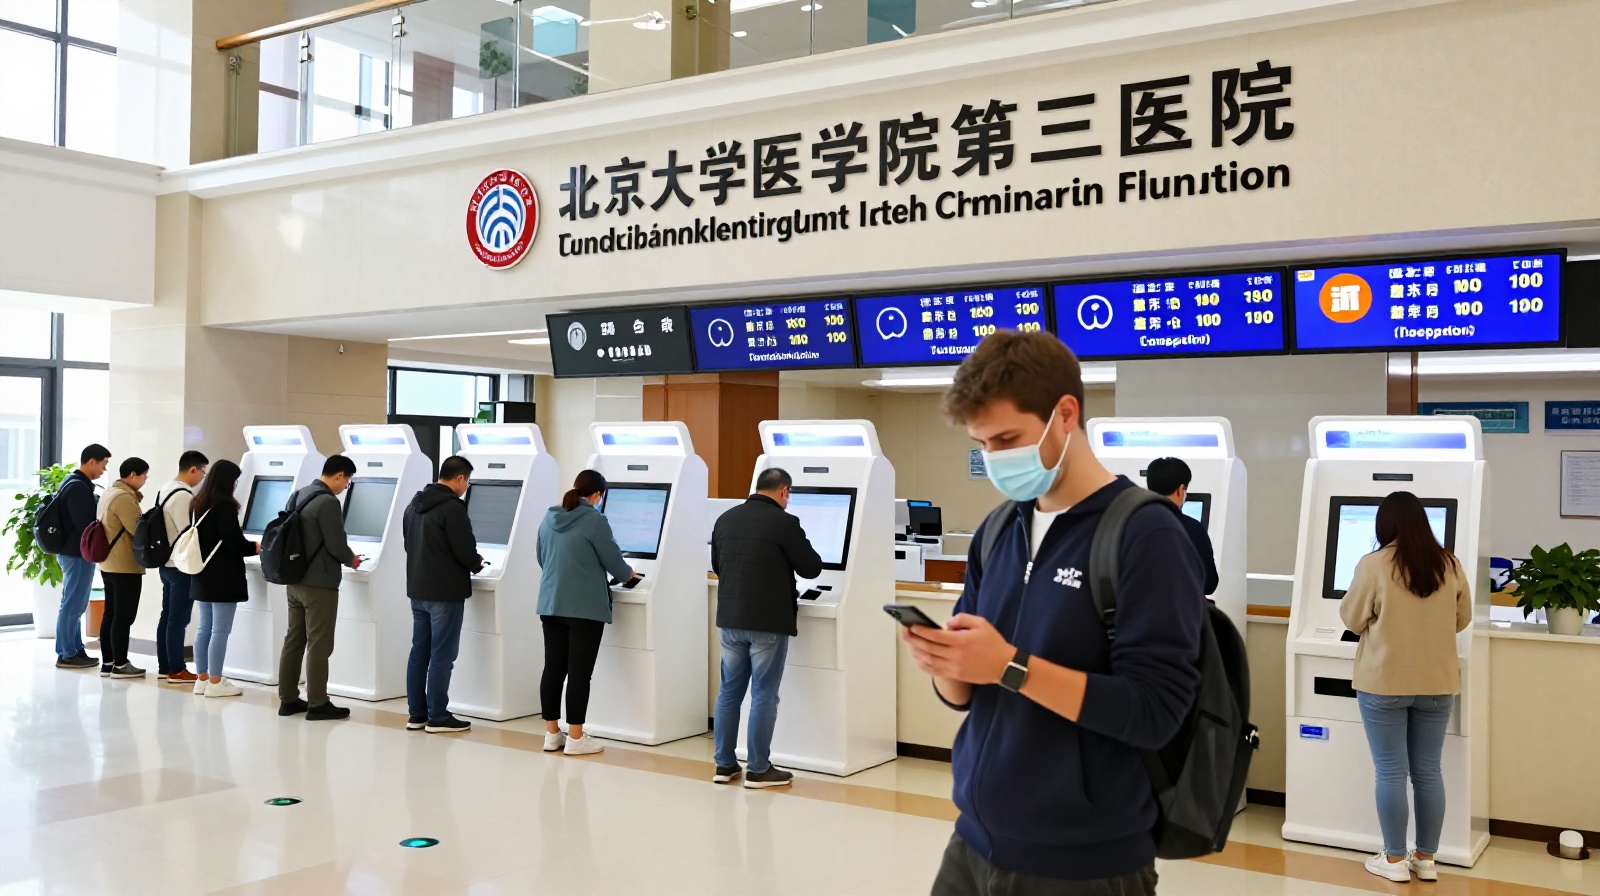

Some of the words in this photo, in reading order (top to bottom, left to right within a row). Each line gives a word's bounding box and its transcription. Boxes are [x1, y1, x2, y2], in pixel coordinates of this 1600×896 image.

[558, 59, 1295, 221] 北京大学医学院第三医院
[1508, 272, 1543, 289] 100
[1454, 301, 1483, 315] 100
[1195, 313, 1221, 327] 100
[972, 324, 996, 337] 100
